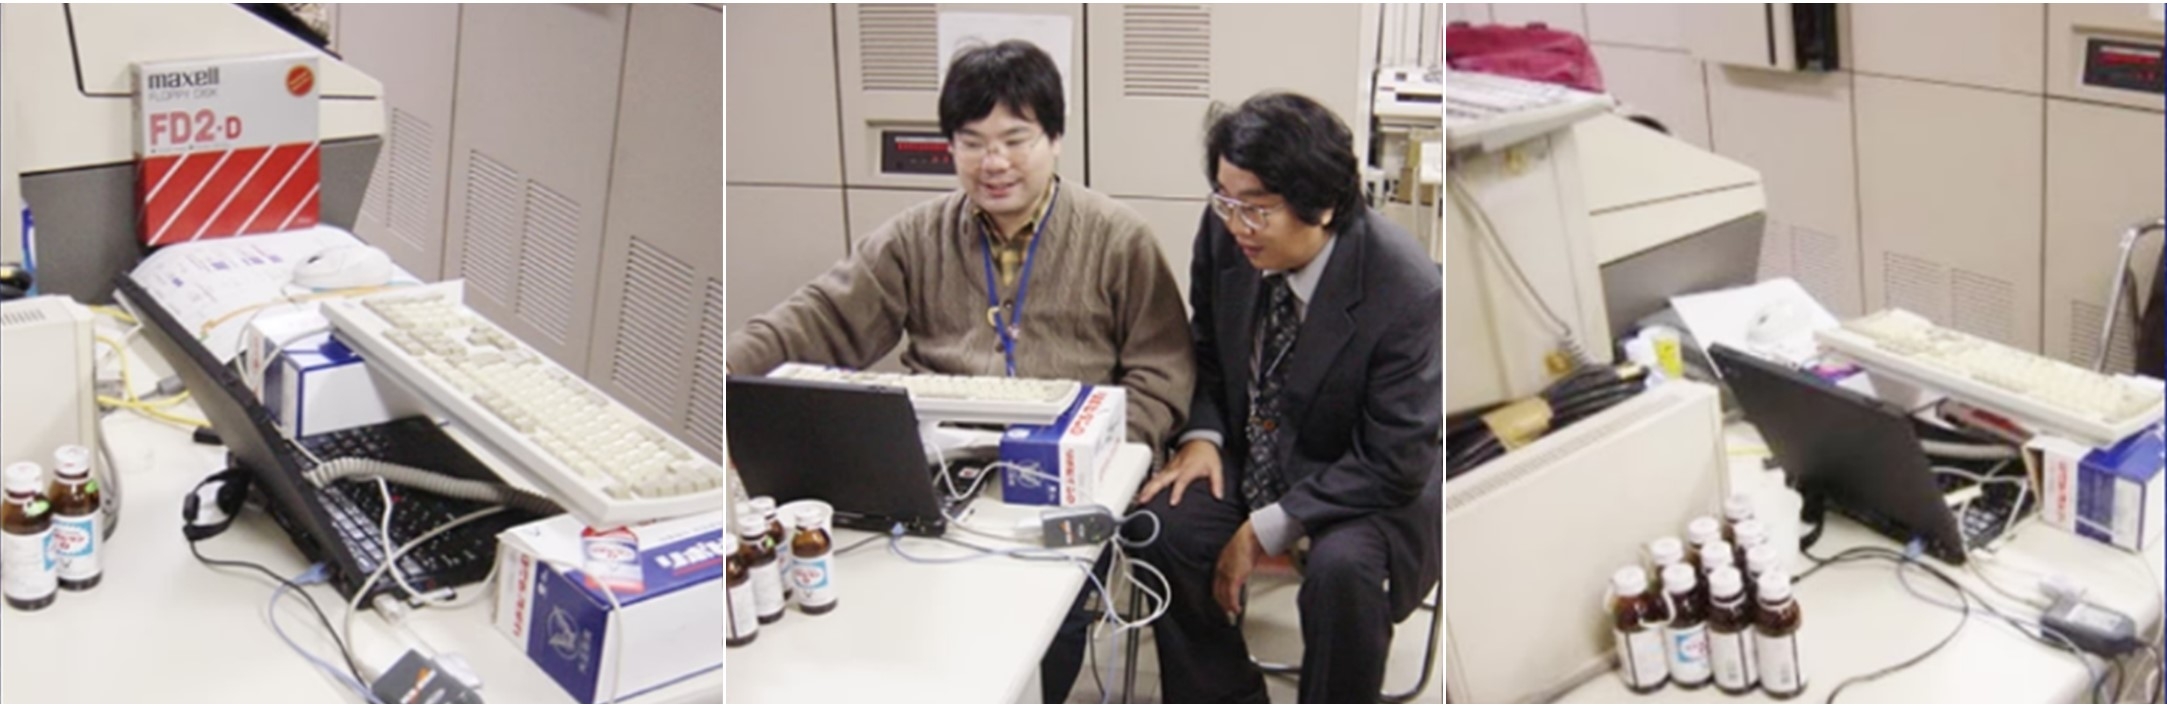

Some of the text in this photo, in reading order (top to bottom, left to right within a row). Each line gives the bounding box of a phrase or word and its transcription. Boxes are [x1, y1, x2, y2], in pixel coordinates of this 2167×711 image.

[148, 67, 220, 89] maxell
[149, 87, 217, 101] FLOPPY DISK
